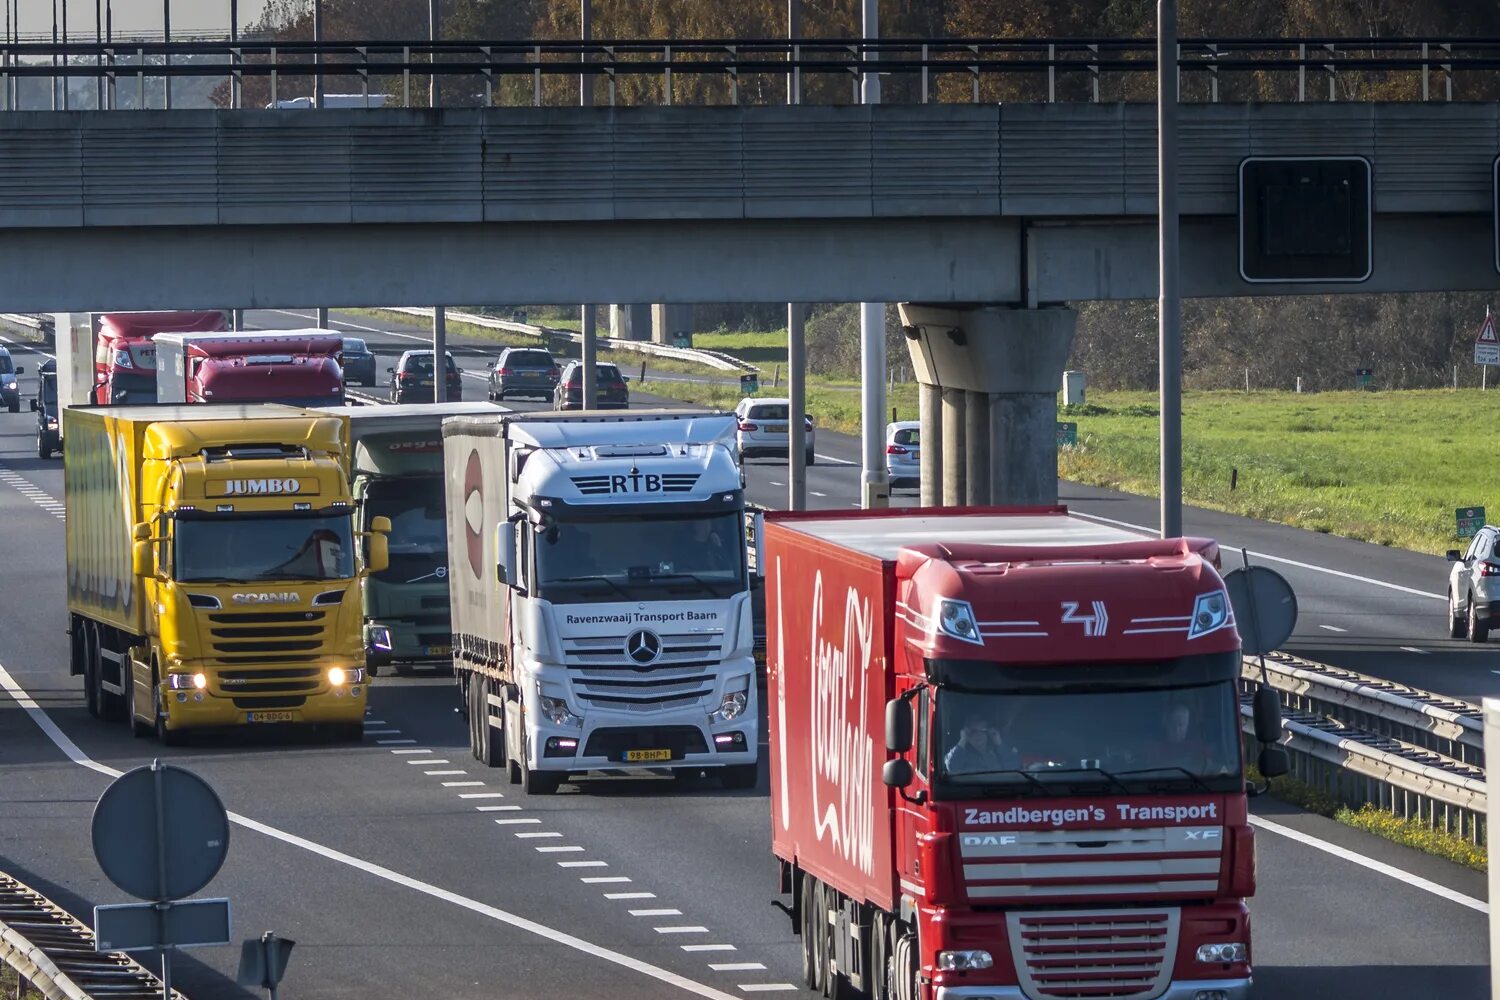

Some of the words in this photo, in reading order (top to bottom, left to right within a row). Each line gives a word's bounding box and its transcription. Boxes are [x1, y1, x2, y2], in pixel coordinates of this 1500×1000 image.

[224, 478, 301, 495] JUMBO
[611, 473, 662, 493] RTB
[232, 592, 301, 605] SCANIA
[566, 612, 632, 625] Ravenzwaaij
[633, 611, 685, 623] Transport
[687, 611, 718, 621] Baarn
[253, 711, 291, 721] 04-BDG-6
[630, 751, 668, 760] 98-BHP-1
[964, 804, 1106, 826] Zandbergen's
[1116, 802, 1217, 822] Transport
[964, 835, 1017, 846] DAF
[1184, 829, 1220, 840] XF
